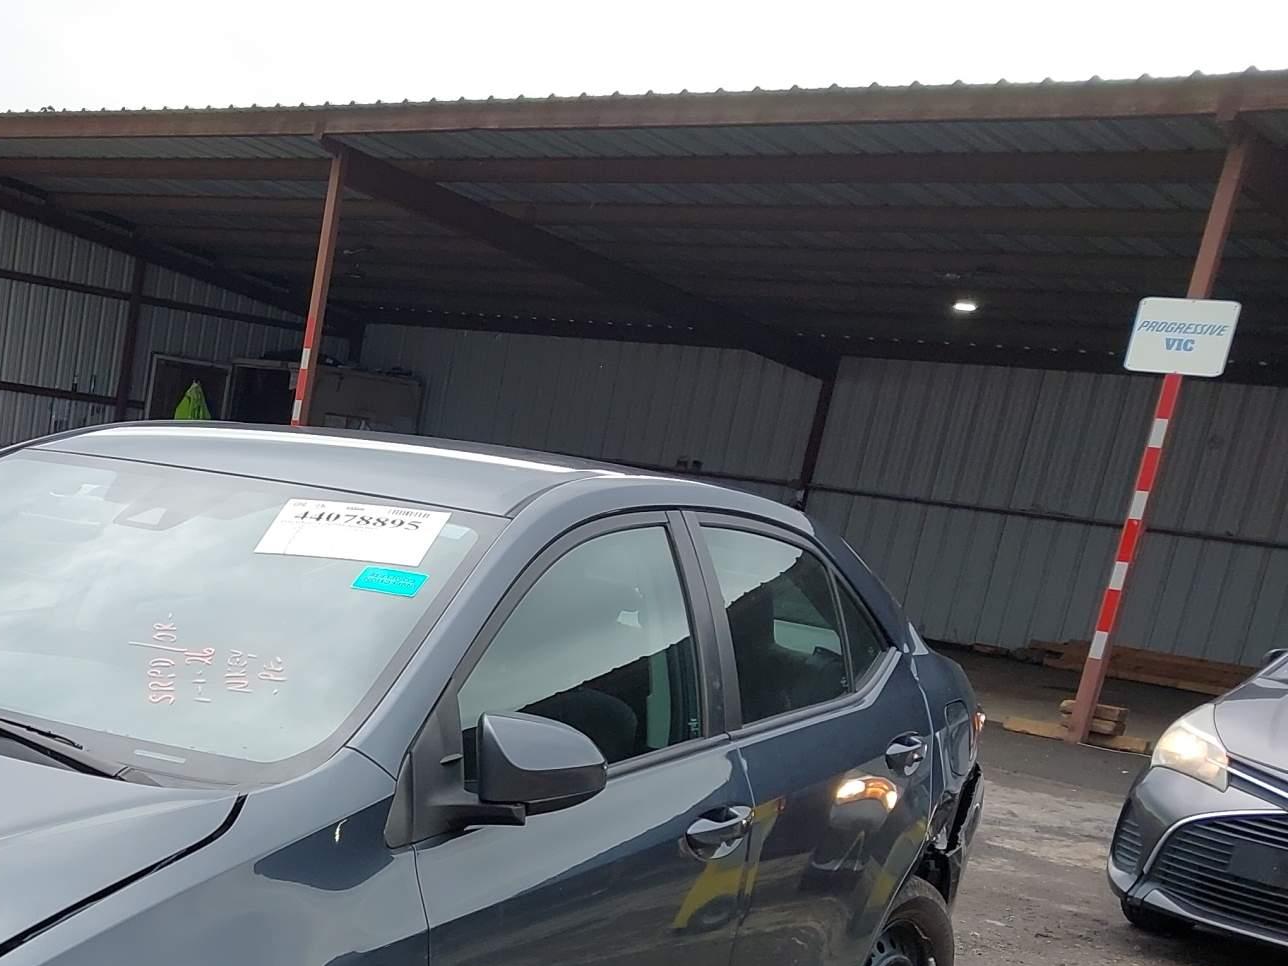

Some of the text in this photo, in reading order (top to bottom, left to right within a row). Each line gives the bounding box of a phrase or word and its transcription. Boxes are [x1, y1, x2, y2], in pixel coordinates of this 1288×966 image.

[1137, 320, 1231, 337] PROGRESSIVE
[1165, 337, 1195, 352] VIC
[294, 510, 423, 531] 44078895
